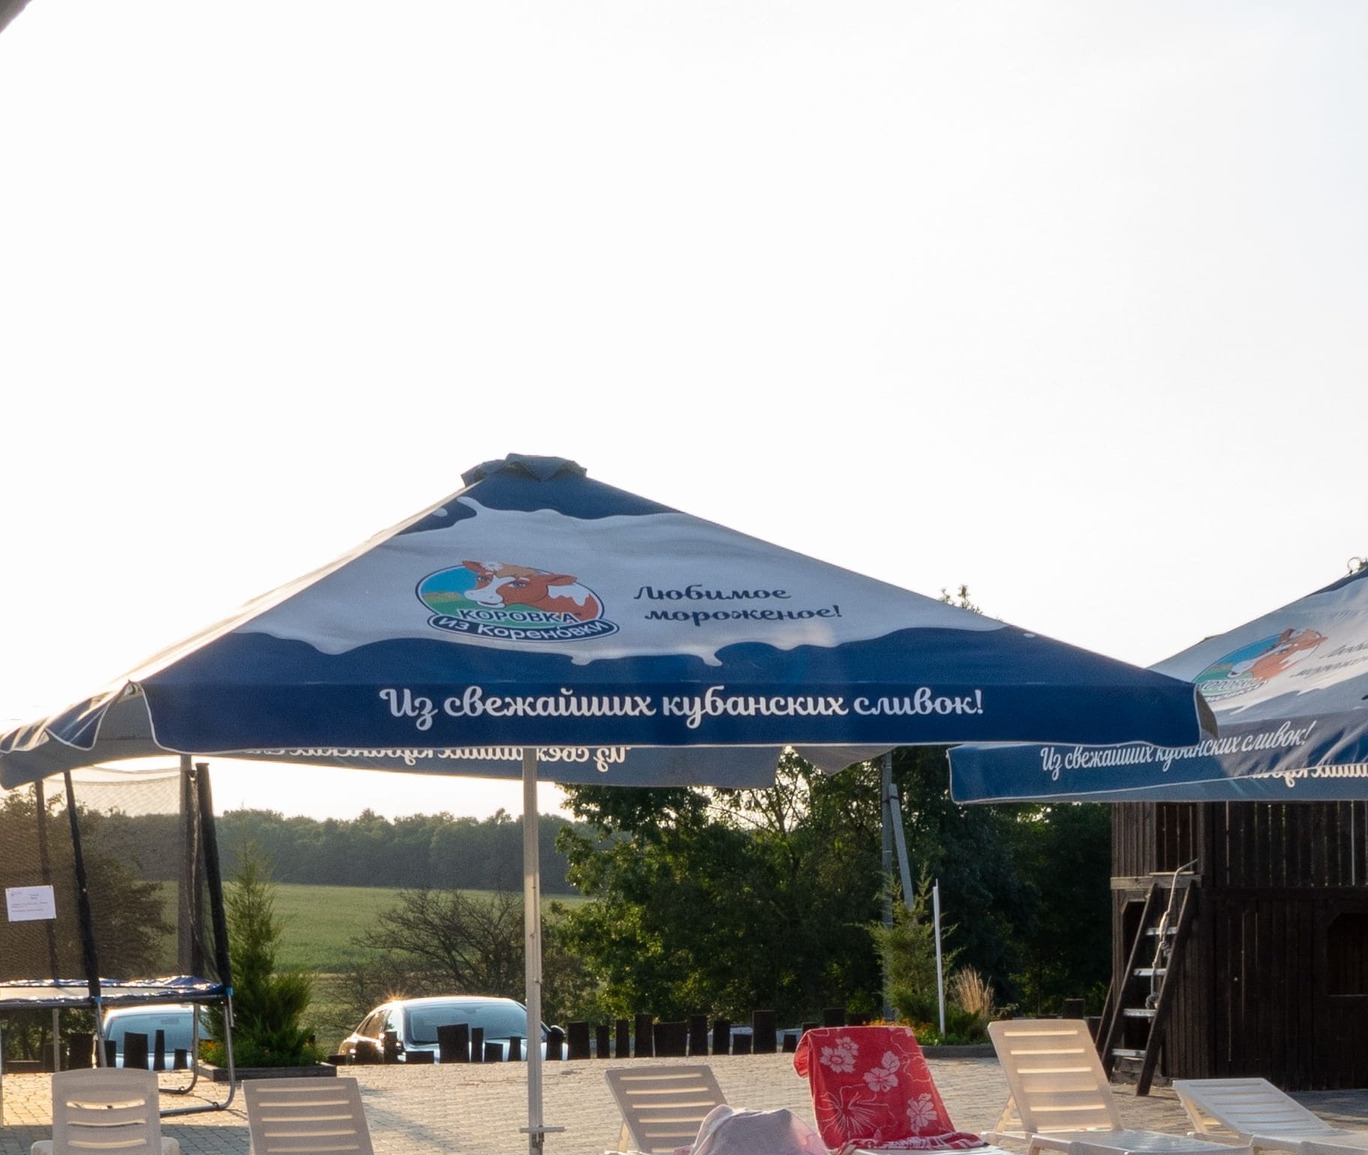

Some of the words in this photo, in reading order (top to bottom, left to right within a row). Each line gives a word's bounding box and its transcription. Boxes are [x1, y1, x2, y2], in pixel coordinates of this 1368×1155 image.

[634, 584, 791, 600] Любимое
[459, 609, 579, 625] КОРОВКА
[645, 605, 842, 627] мороженое!
[380, 688, 438, 730] Из
[444, 686, 656, 717] свежайших
[662, 685, 850, 729] кубанских
[853, 687, 984, 716] сливок!
[1040, 747, 1063, 781] Из
[1241, 720, 1317, 753] сливок!
